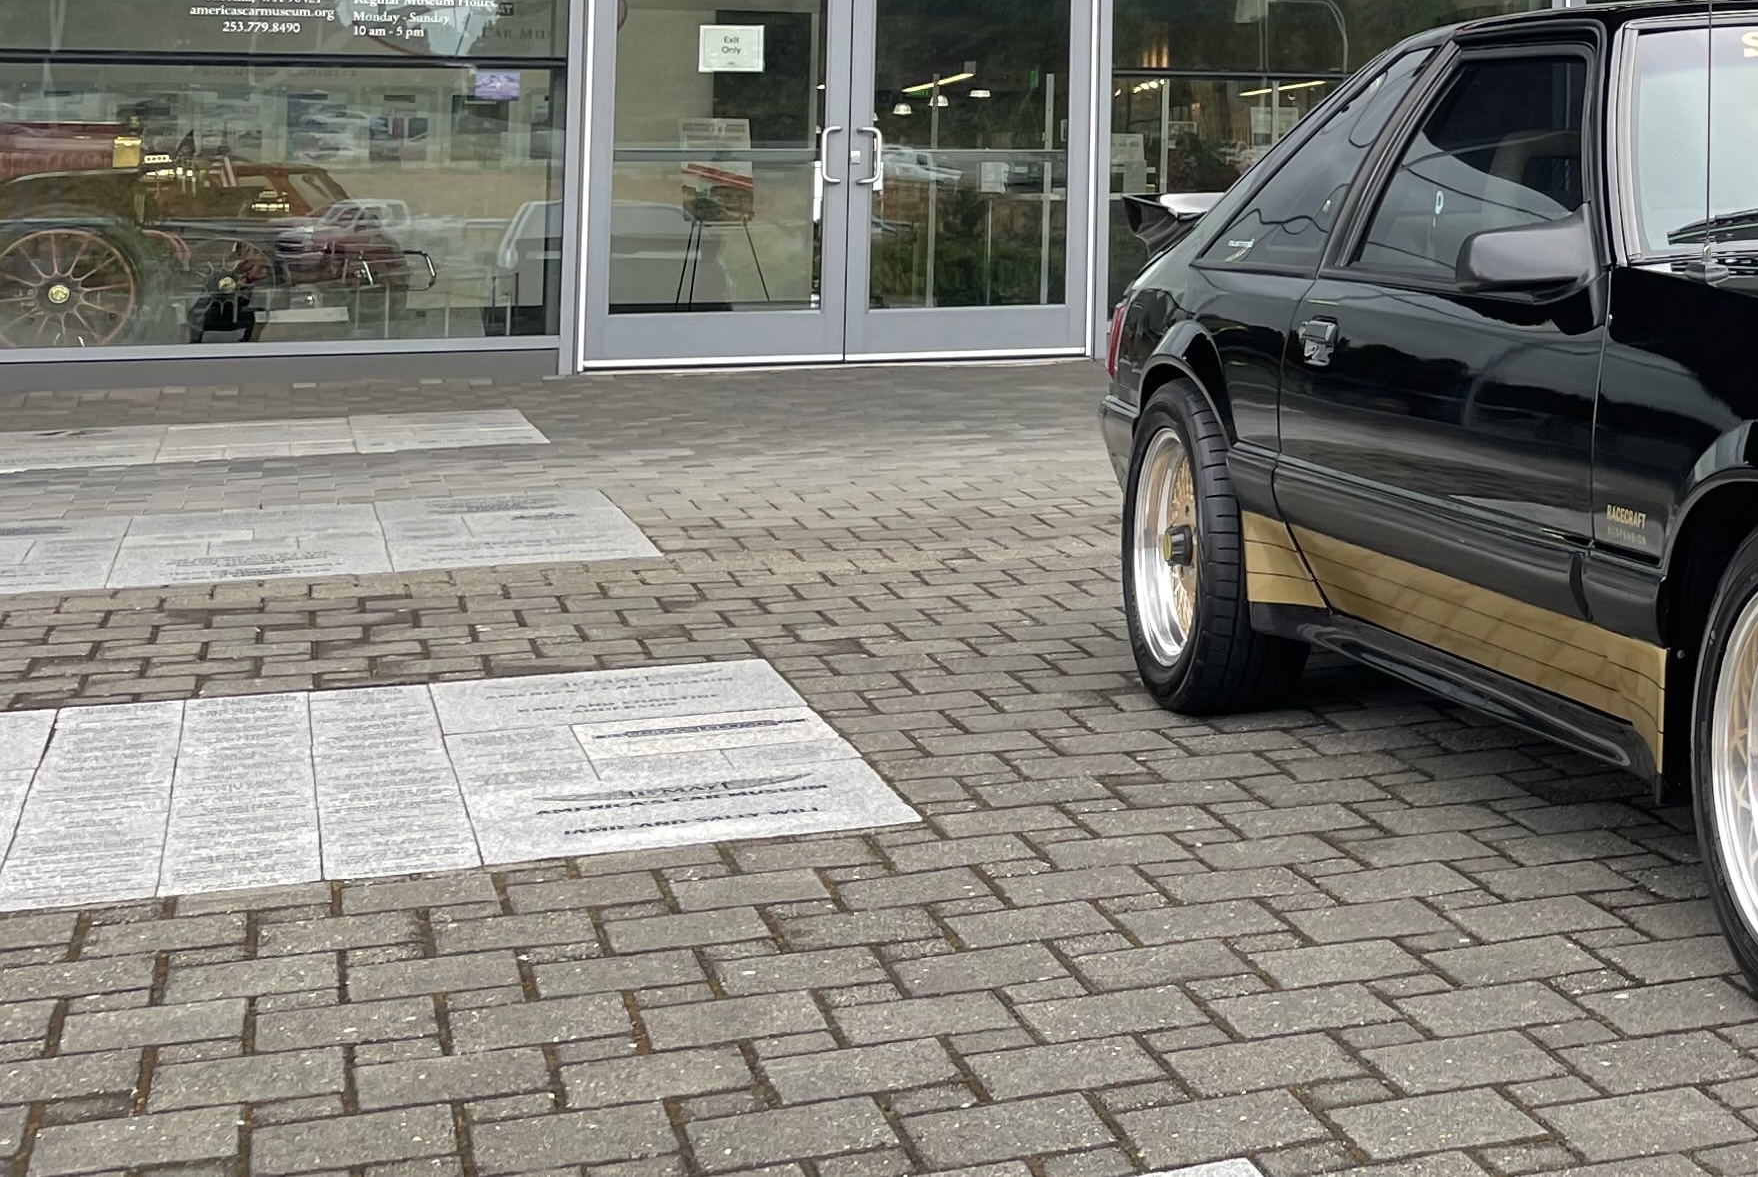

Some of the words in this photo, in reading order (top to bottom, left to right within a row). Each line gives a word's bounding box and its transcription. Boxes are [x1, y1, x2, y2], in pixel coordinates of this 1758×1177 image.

[189, 5, 335, 21] americascarmuseum.org
[353, 11, 400, 24] Monday
[408, 12, 450, 24] Sunday
[222, 20, 301, 34] 253.779.8490
[353, 26, 366, 36] 10
[368, 28, 386, 37] am
[396, 26, 403, 37] 5
[405, 28, 425, 40] pm
[723, 35, 740, 44] Exit
[721, 45, 742, 55] Only
[1606, 504, 1647, 530] RACECRAFT
